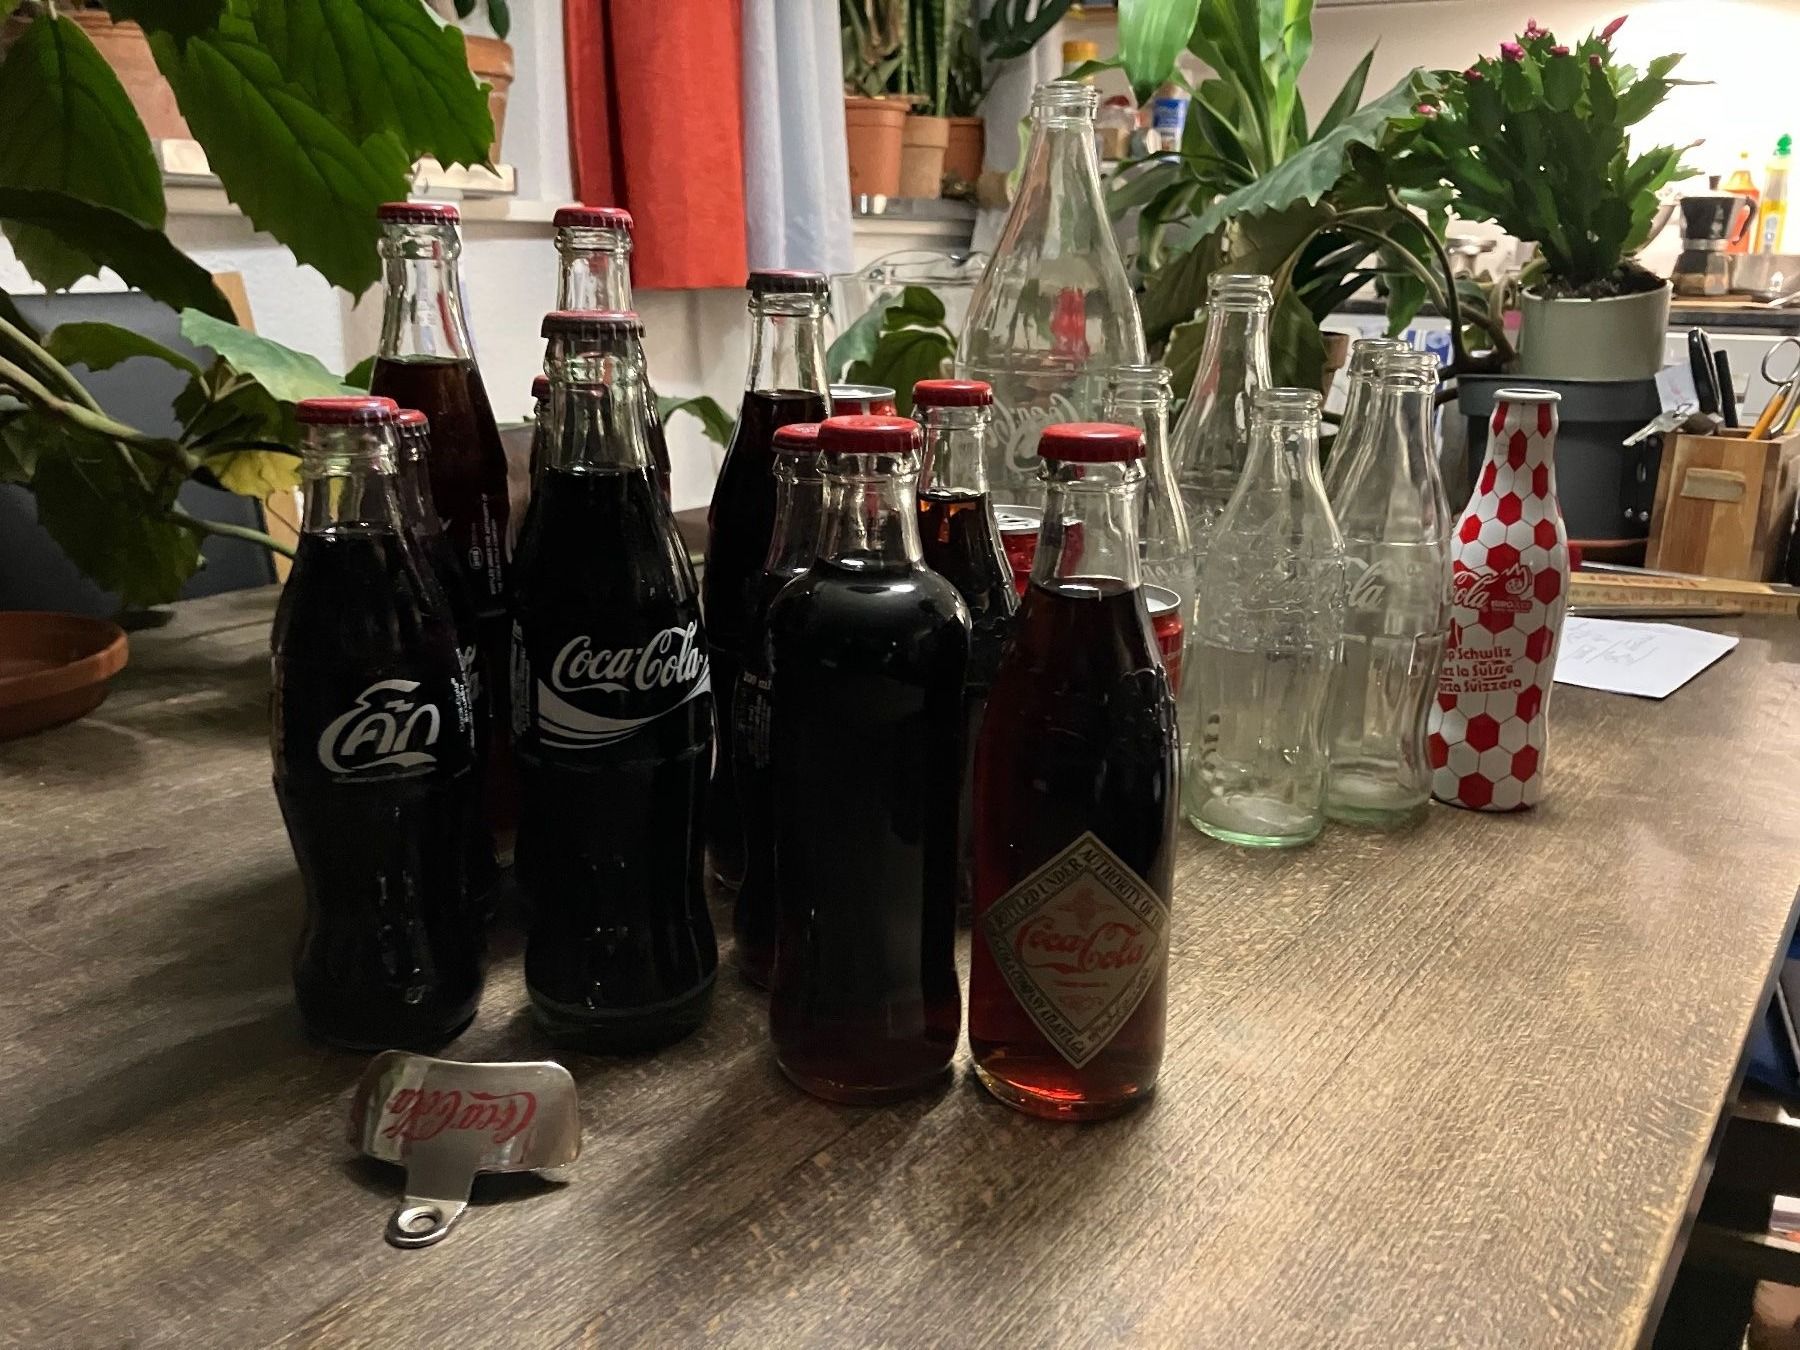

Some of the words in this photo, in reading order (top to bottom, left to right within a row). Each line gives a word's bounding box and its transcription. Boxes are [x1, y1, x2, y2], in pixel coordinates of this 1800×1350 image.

[551, 619, 704, 694] Coca-Cola
[1457, 665, 1469, 677] la
[1472, 663, 1514, 677] Suisse
[1464, 679, 1522, 693] Svizzera
[1080, 849, 1143, 907] AUTHORITY
[381, 1088, 537, 1144] Coca-Cola
